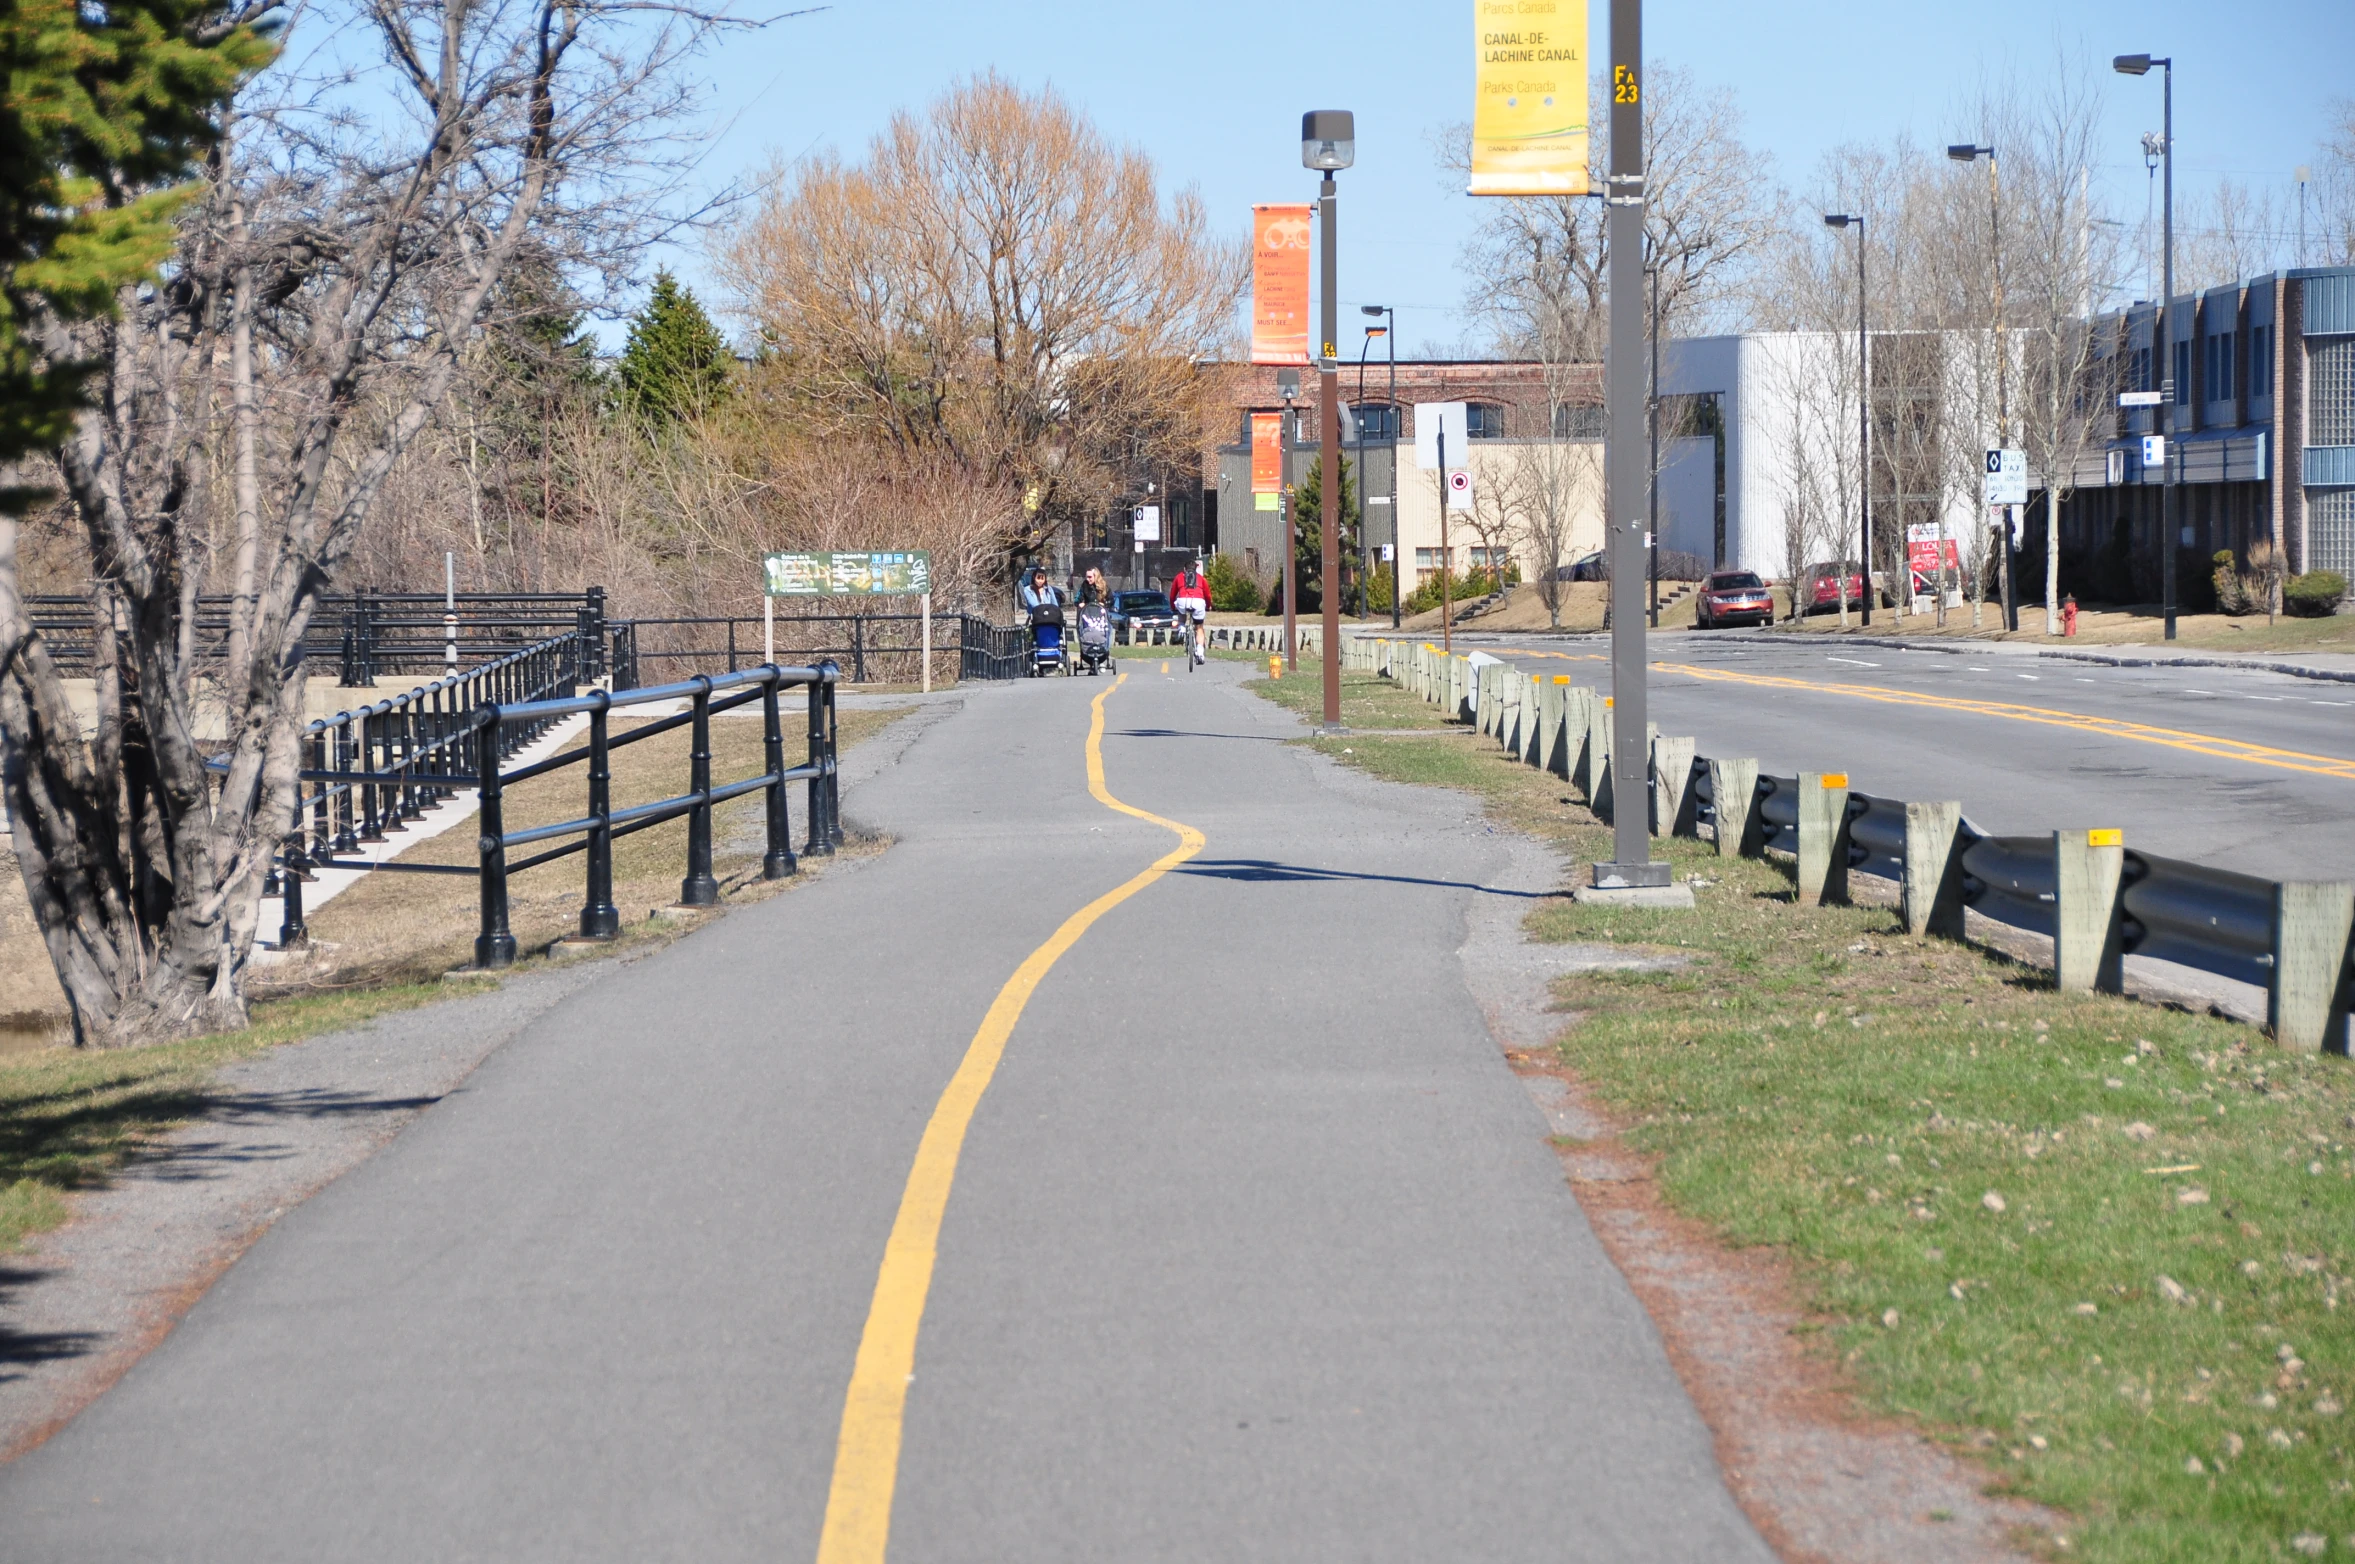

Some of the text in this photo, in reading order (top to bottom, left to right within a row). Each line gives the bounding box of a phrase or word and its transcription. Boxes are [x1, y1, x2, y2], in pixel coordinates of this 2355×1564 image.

[1483, 0, 1556, 14] Parcs Canada
[1484, 32, 1550, 45] CANAL-DE-
[1485, 49, 1578, 62] LACHINE CANAL
[1484, 80, 1556, 93] Parks Canada
[1614, 85, 1638, 103] 23
[2003, 454, 2024, 462] BUS
